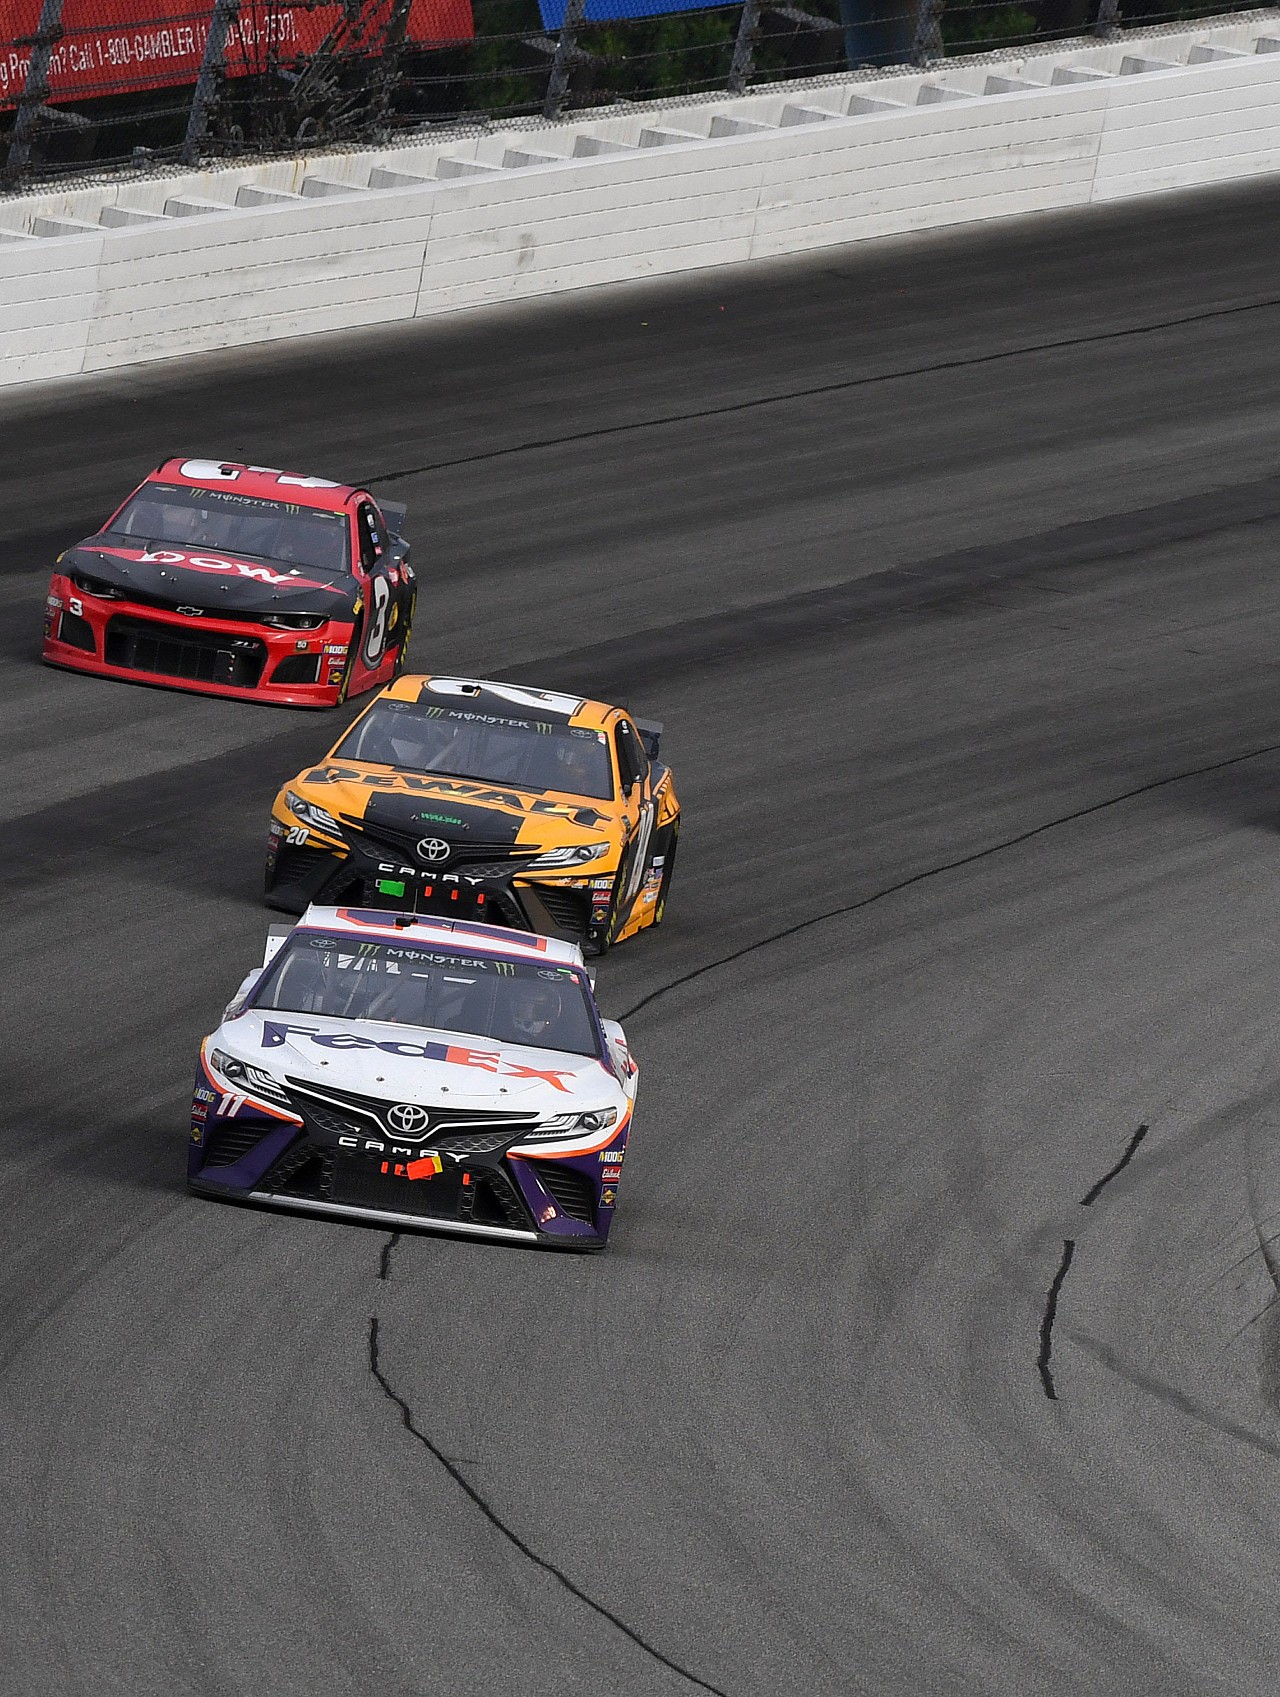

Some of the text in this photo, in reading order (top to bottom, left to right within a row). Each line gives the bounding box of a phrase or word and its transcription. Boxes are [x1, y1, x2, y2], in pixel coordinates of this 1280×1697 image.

[9, 46, 67, 80] Prom?
[70, 42, 95, 72] Call
[96, 26, 195, 66] 1-800-GAMBLER
[209, 492, 280, 509] MONSTER
[69, 597, 83, 616] 3
[448, 711, 530, 729] MONSTER
[286, 826, 310, 846] 20
[386, 948, 488, 970] MONSTER
[261, 1021, 577, 1095] FedEx
[216, 1092, 249, 1118] 11
